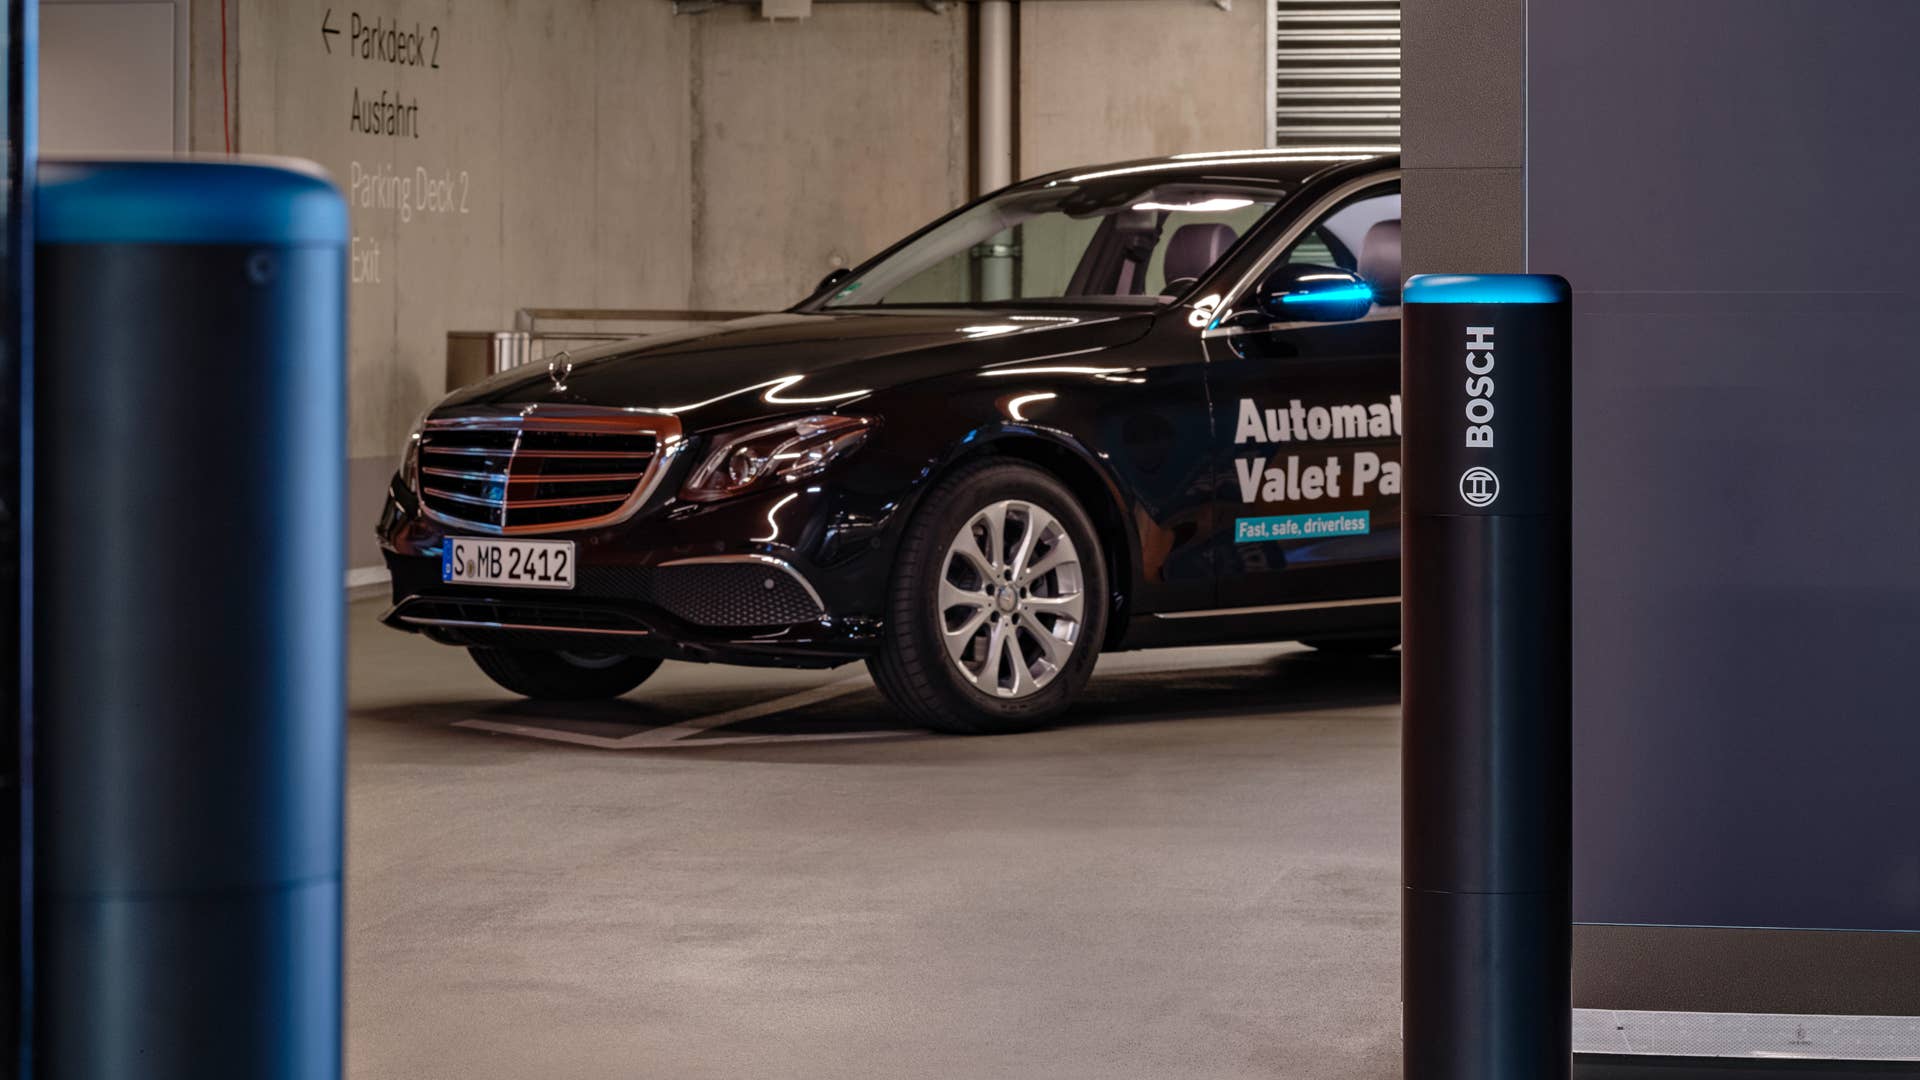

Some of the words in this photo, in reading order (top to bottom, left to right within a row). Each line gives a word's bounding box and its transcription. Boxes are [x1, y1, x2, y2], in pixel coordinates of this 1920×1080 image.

[351, 12, 425, 67] Parkdeck
[430, 26, 440, 69] 2
[351, 87, 419, 138] Ausfahrt
[351, 161, 411, 222] Parking
[416, 166, 454, 212] Deck
[460, 171, 469, 213] 2
[352, 237, 380, 283] Exit
[1465, 326, 1495, 448] BOSCH
[1234, 455, 1341, 503] Valet
[1239, 522, 1269, 538] Fast,
[1271, 519, 1301, 536] safe,
[1304, 516, 1365, 533] driverless
[454, 544, 465, 576] S
[477, 546, 503, 579] MB
[508, 547, 567, 581] 2412
